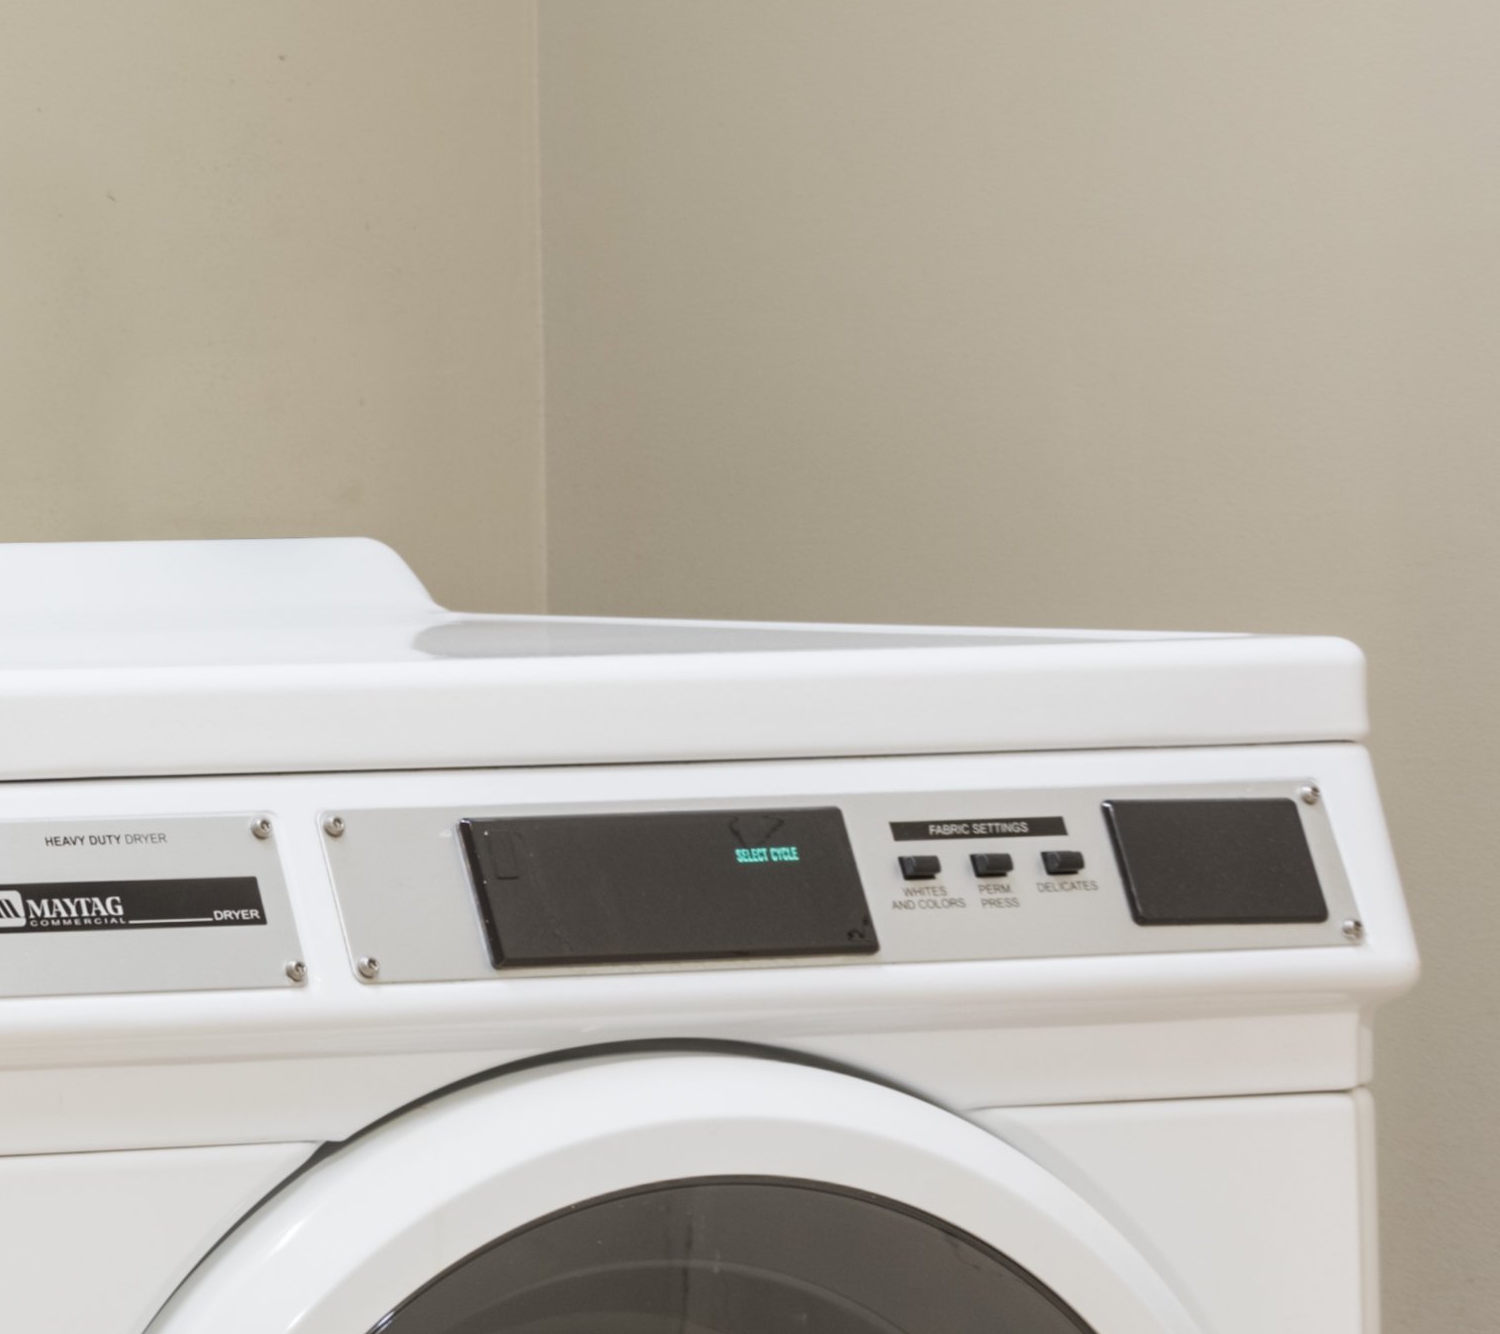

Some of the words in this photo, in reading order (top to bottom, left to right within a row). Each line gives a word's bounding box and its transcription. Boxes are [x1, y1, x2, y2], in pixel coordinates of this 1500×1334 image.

[929, 823, 968, 835] FABRIC
[972, 822, 1029, 835] SETTINGS
[45, 836, 83, 847] HEAVY
[88, 835, 120, 845] DUTY
[125, 833, 167, 845] DRYER
[736, 848, 768, 863] SELECT
[771, 847, 799, 862] CYCLE
[903, 886, 947, 897] WHITES
[1037, 880, 1098, 893] DELICATES
[27, 896, 123, 918] MAYTAG
[892, 899, 914, 910] AND
[916, 897, 966, 909] COLORS
[981, 897, 1020, 909] PRESS
[29, 916, 126, 927] COMMERCIAL
[214, 909, 260, 921] DRYER
